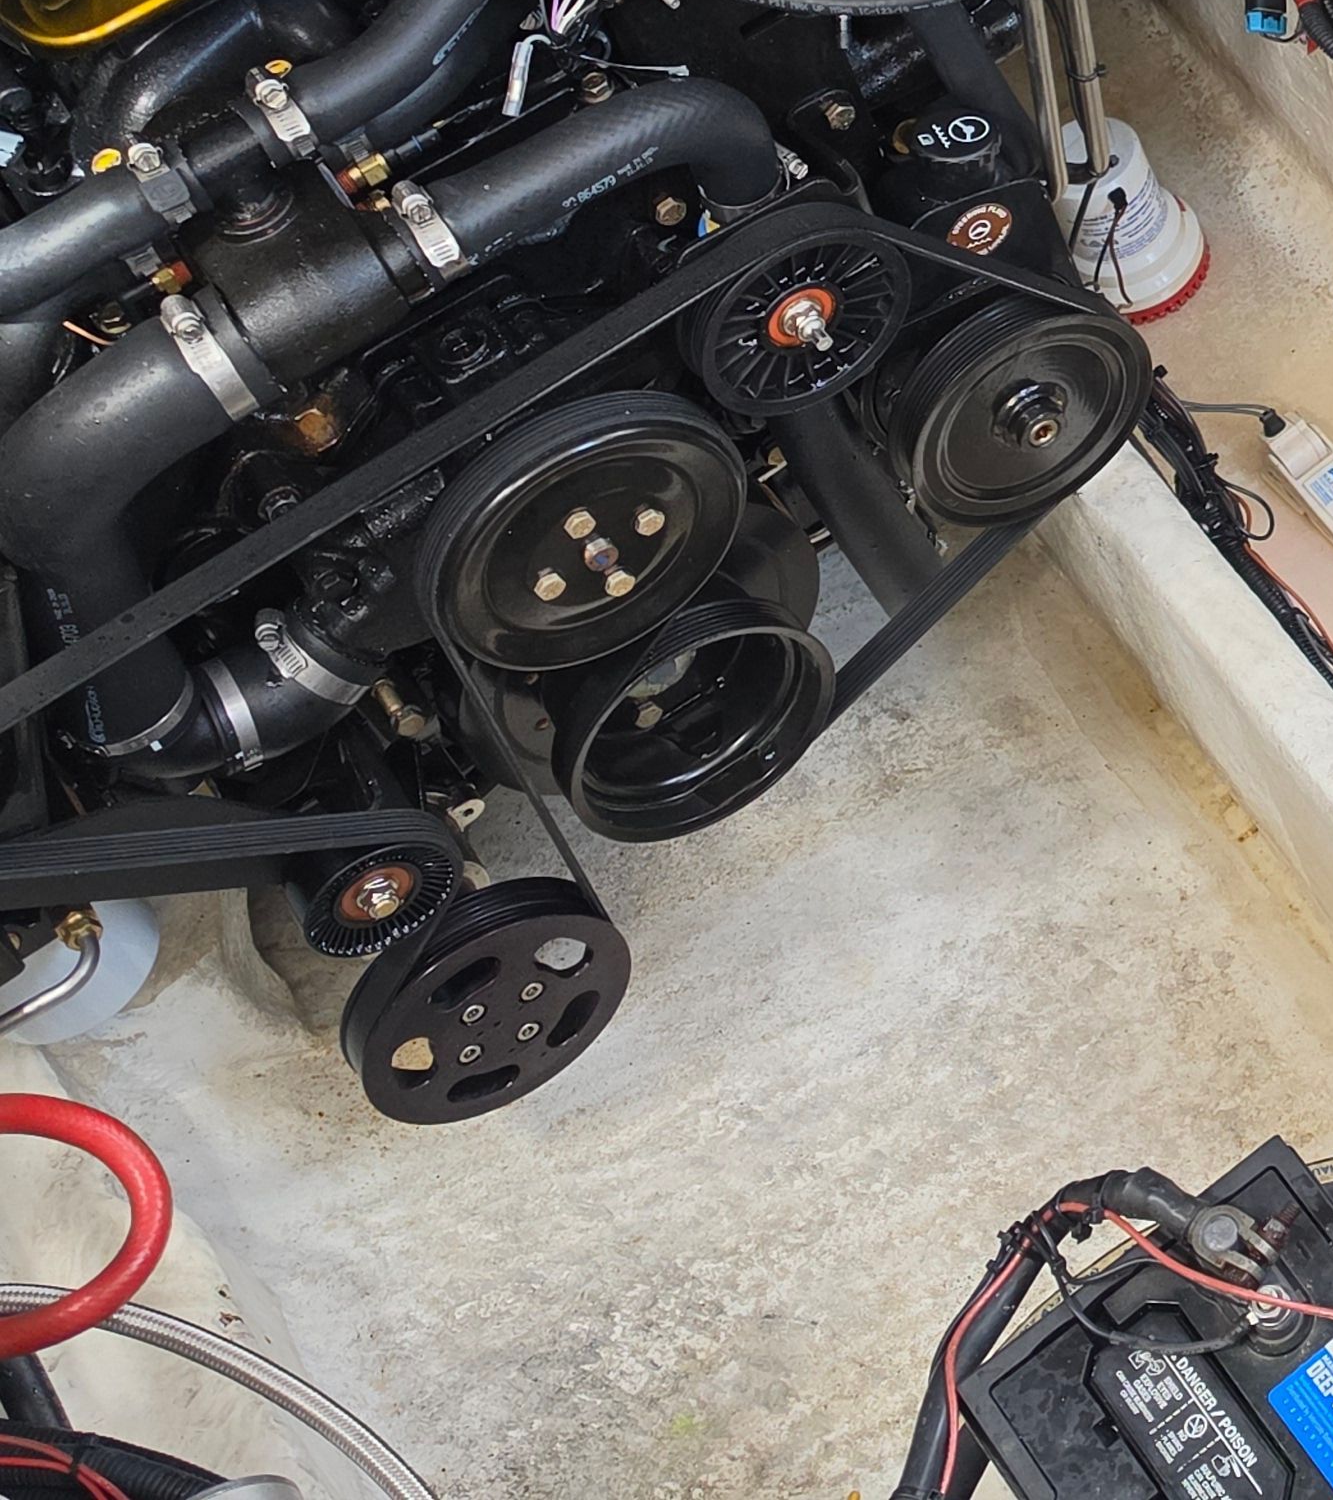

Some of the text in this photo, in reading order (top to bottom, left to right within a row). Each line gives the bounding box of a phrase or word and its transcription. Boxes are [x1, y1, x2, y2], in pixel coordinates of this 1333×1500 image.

[1130, 1377, 1153, 1405] GASES
[1138, 1372, 1168, 1411] EXPLOSIVE
[1154, 1380, 1173, 1403] EYES
[1161, 1375, 1184, 1402] SHIELD
[1173, 1352, 1221, 1412] DANGER
[1215, 1414, 1260, 1470] POISON
